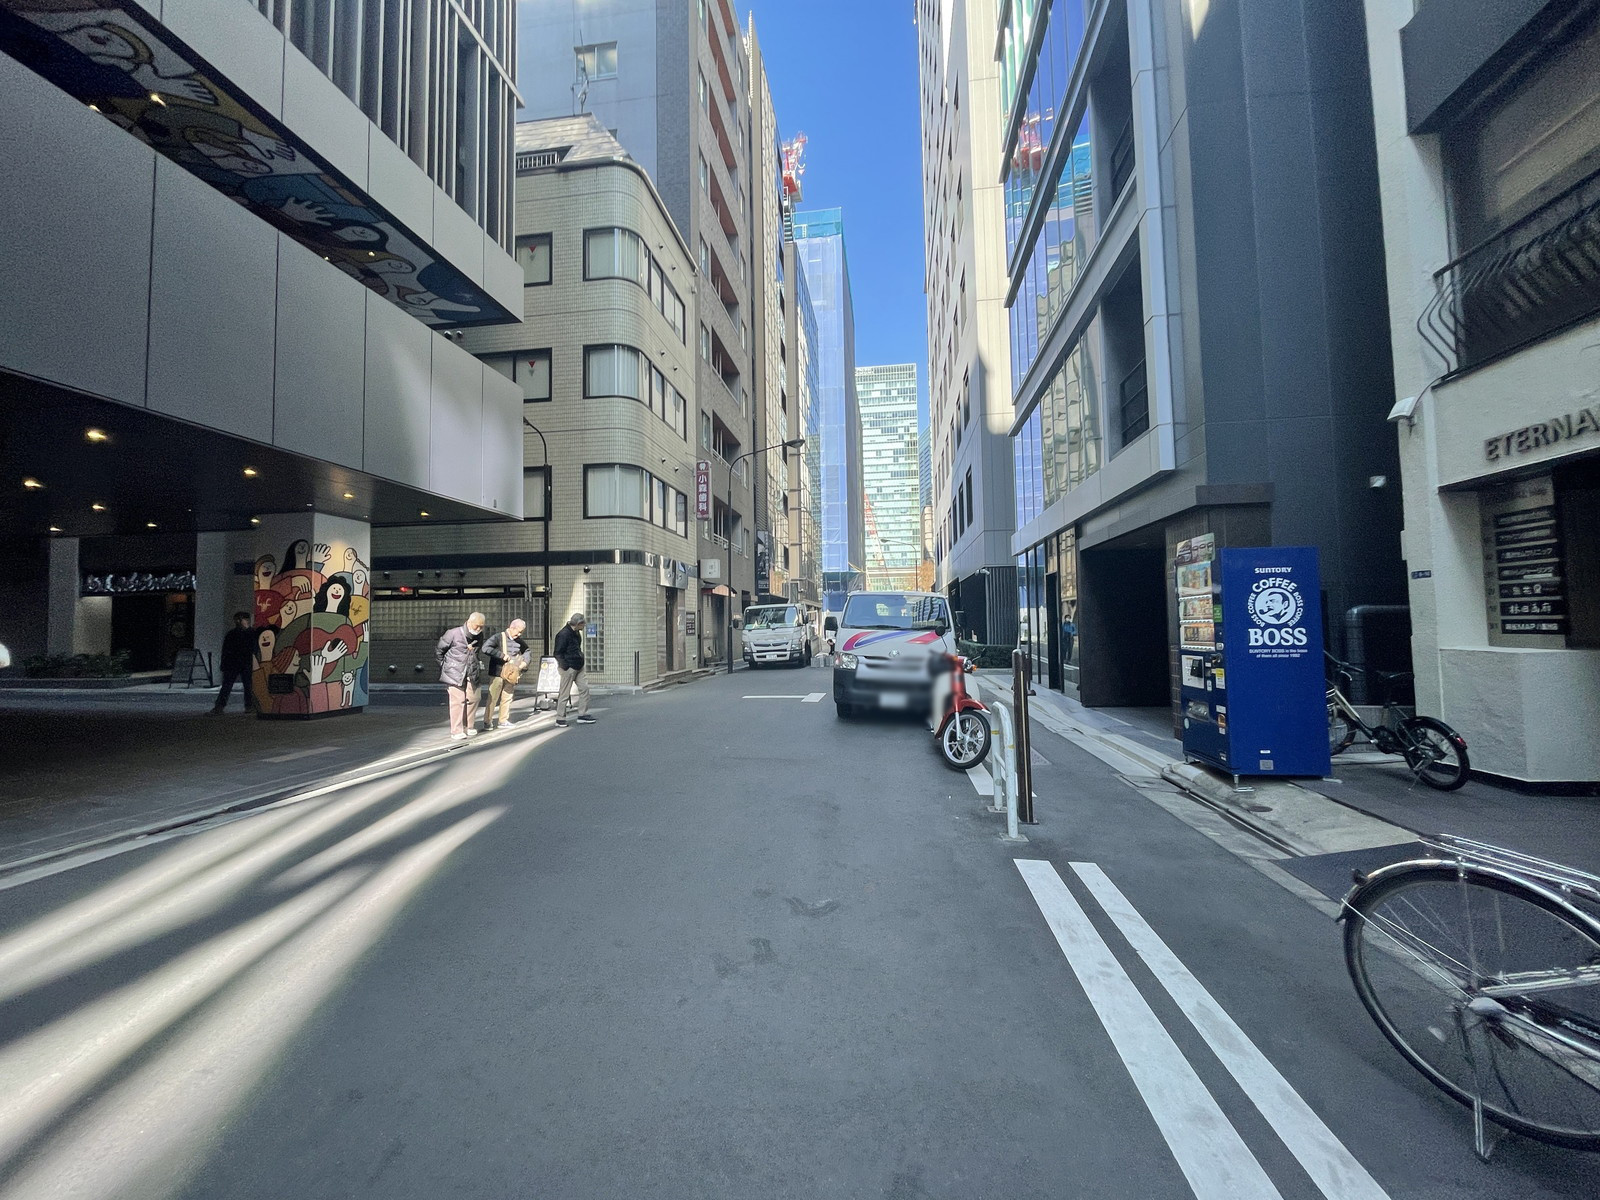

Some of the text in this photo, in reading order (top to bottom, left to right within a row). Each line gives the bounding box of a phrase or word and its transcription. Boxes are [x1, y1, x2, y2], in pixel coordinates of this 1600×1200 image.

[1252, 577, 1297, 593] COFFEE
[1248, 592, 1266, 627] BOSS COFFEE
[1287, 591, 1304, 627] BOSS COFFEE
[1248, 627, 1308, 646] BOSS
